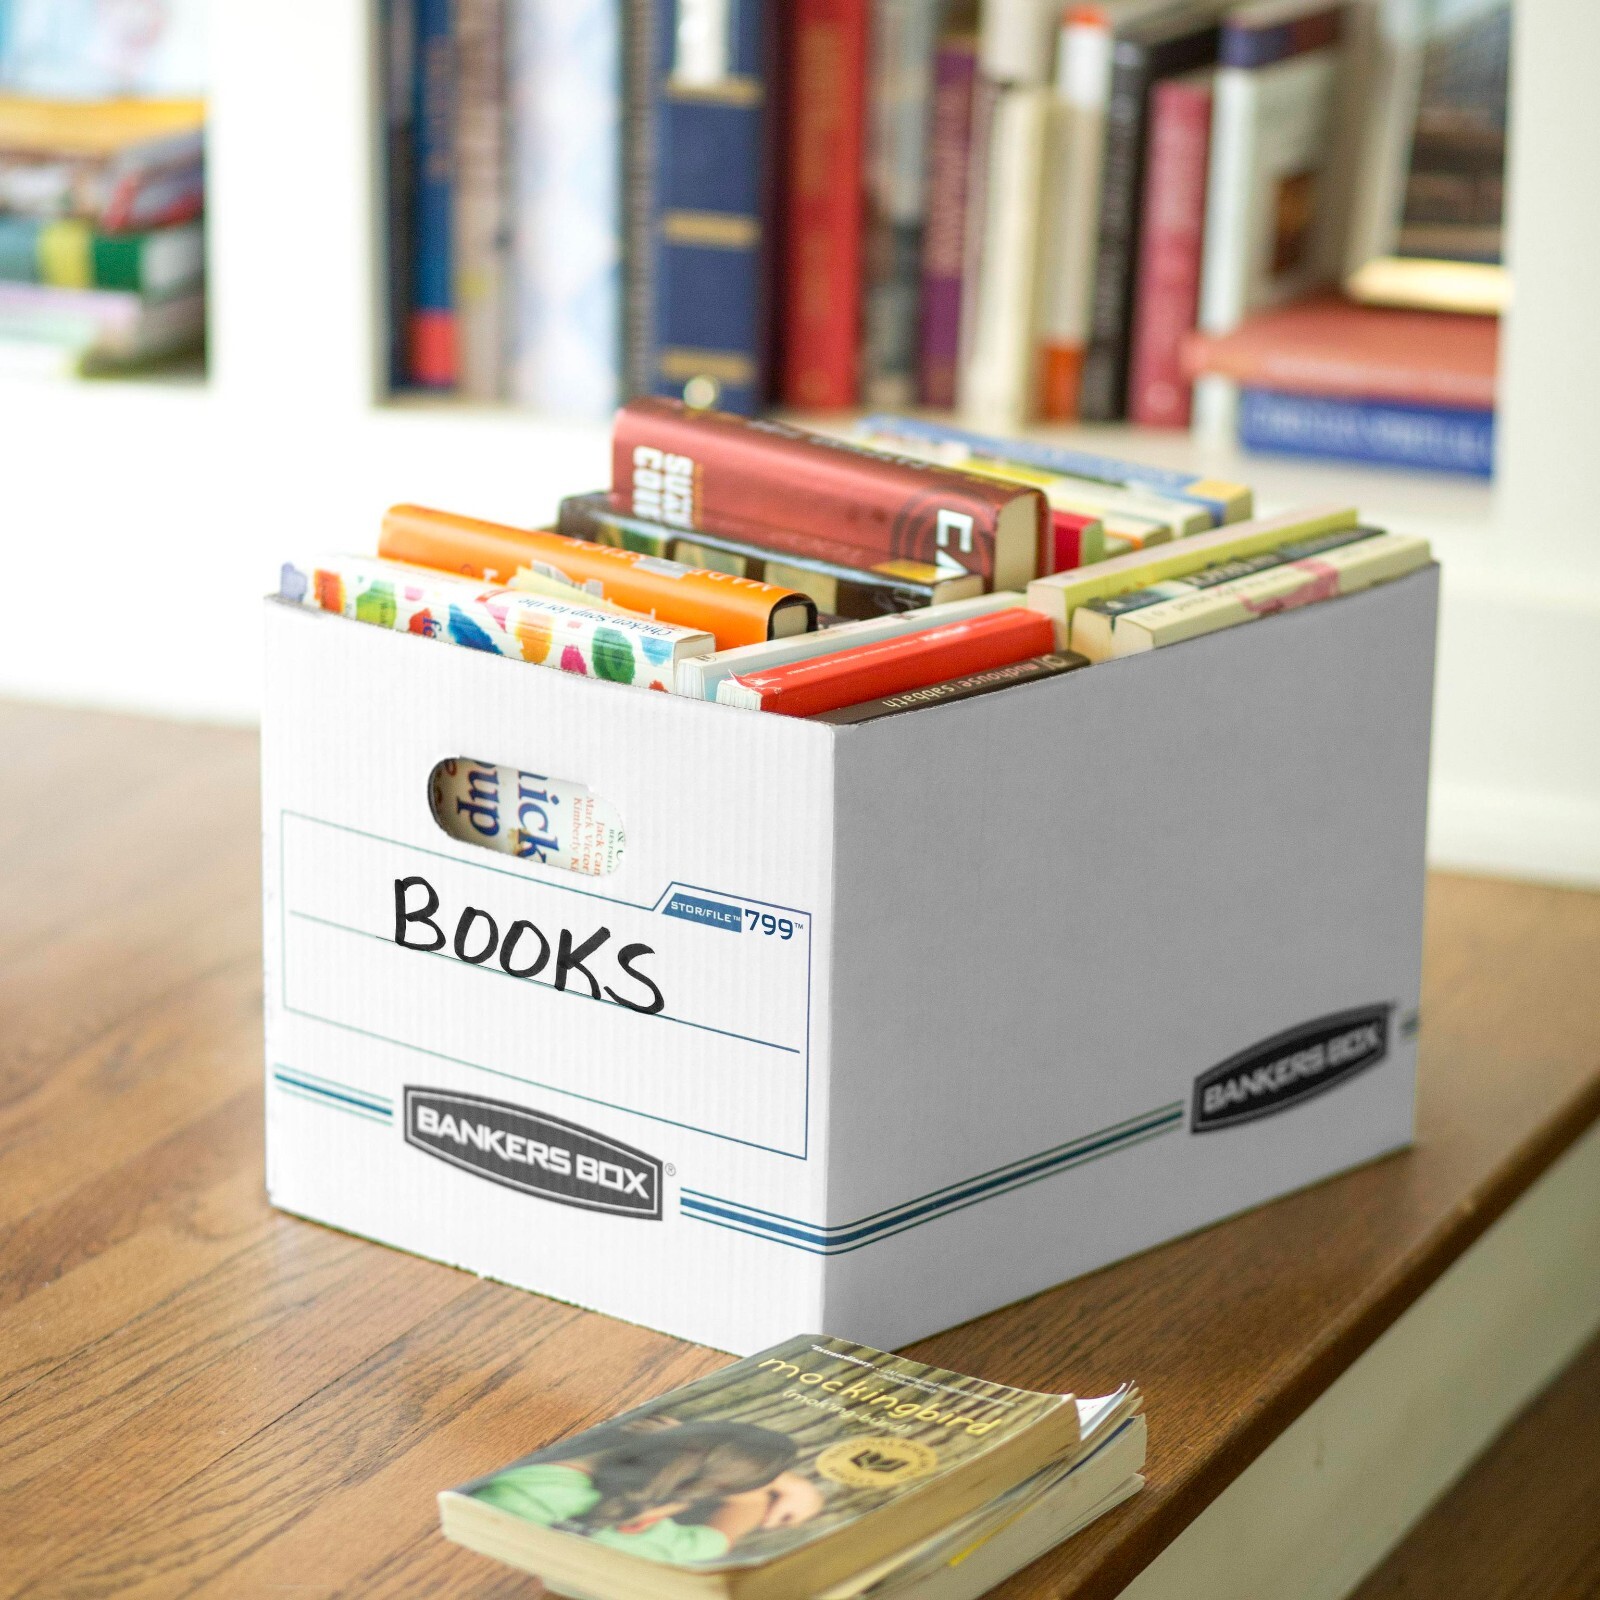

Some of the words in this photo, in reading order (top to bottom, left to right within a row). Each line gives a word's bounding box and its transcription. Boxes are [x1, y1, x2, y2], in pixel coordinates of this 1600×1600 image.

[571, 609, 611, 622] Soup
[612, 617, 673, 636] Chicken
[882, 685, 955, 708] sabbath
[584, 796, 594, 828] Mark
[595, 821, 605, 847] Jack
[394, 876, 665, 1015] BOOKS
[1204, 1042, 1326, 1114] BANKERS
[1327, 1021, 1379, 1066] BOX
[417, 1105, 572, 1176] BANKERS
[576, 1153, 650, 1200] BOX
[758, 1357, 1001, 1436] mockingbird
